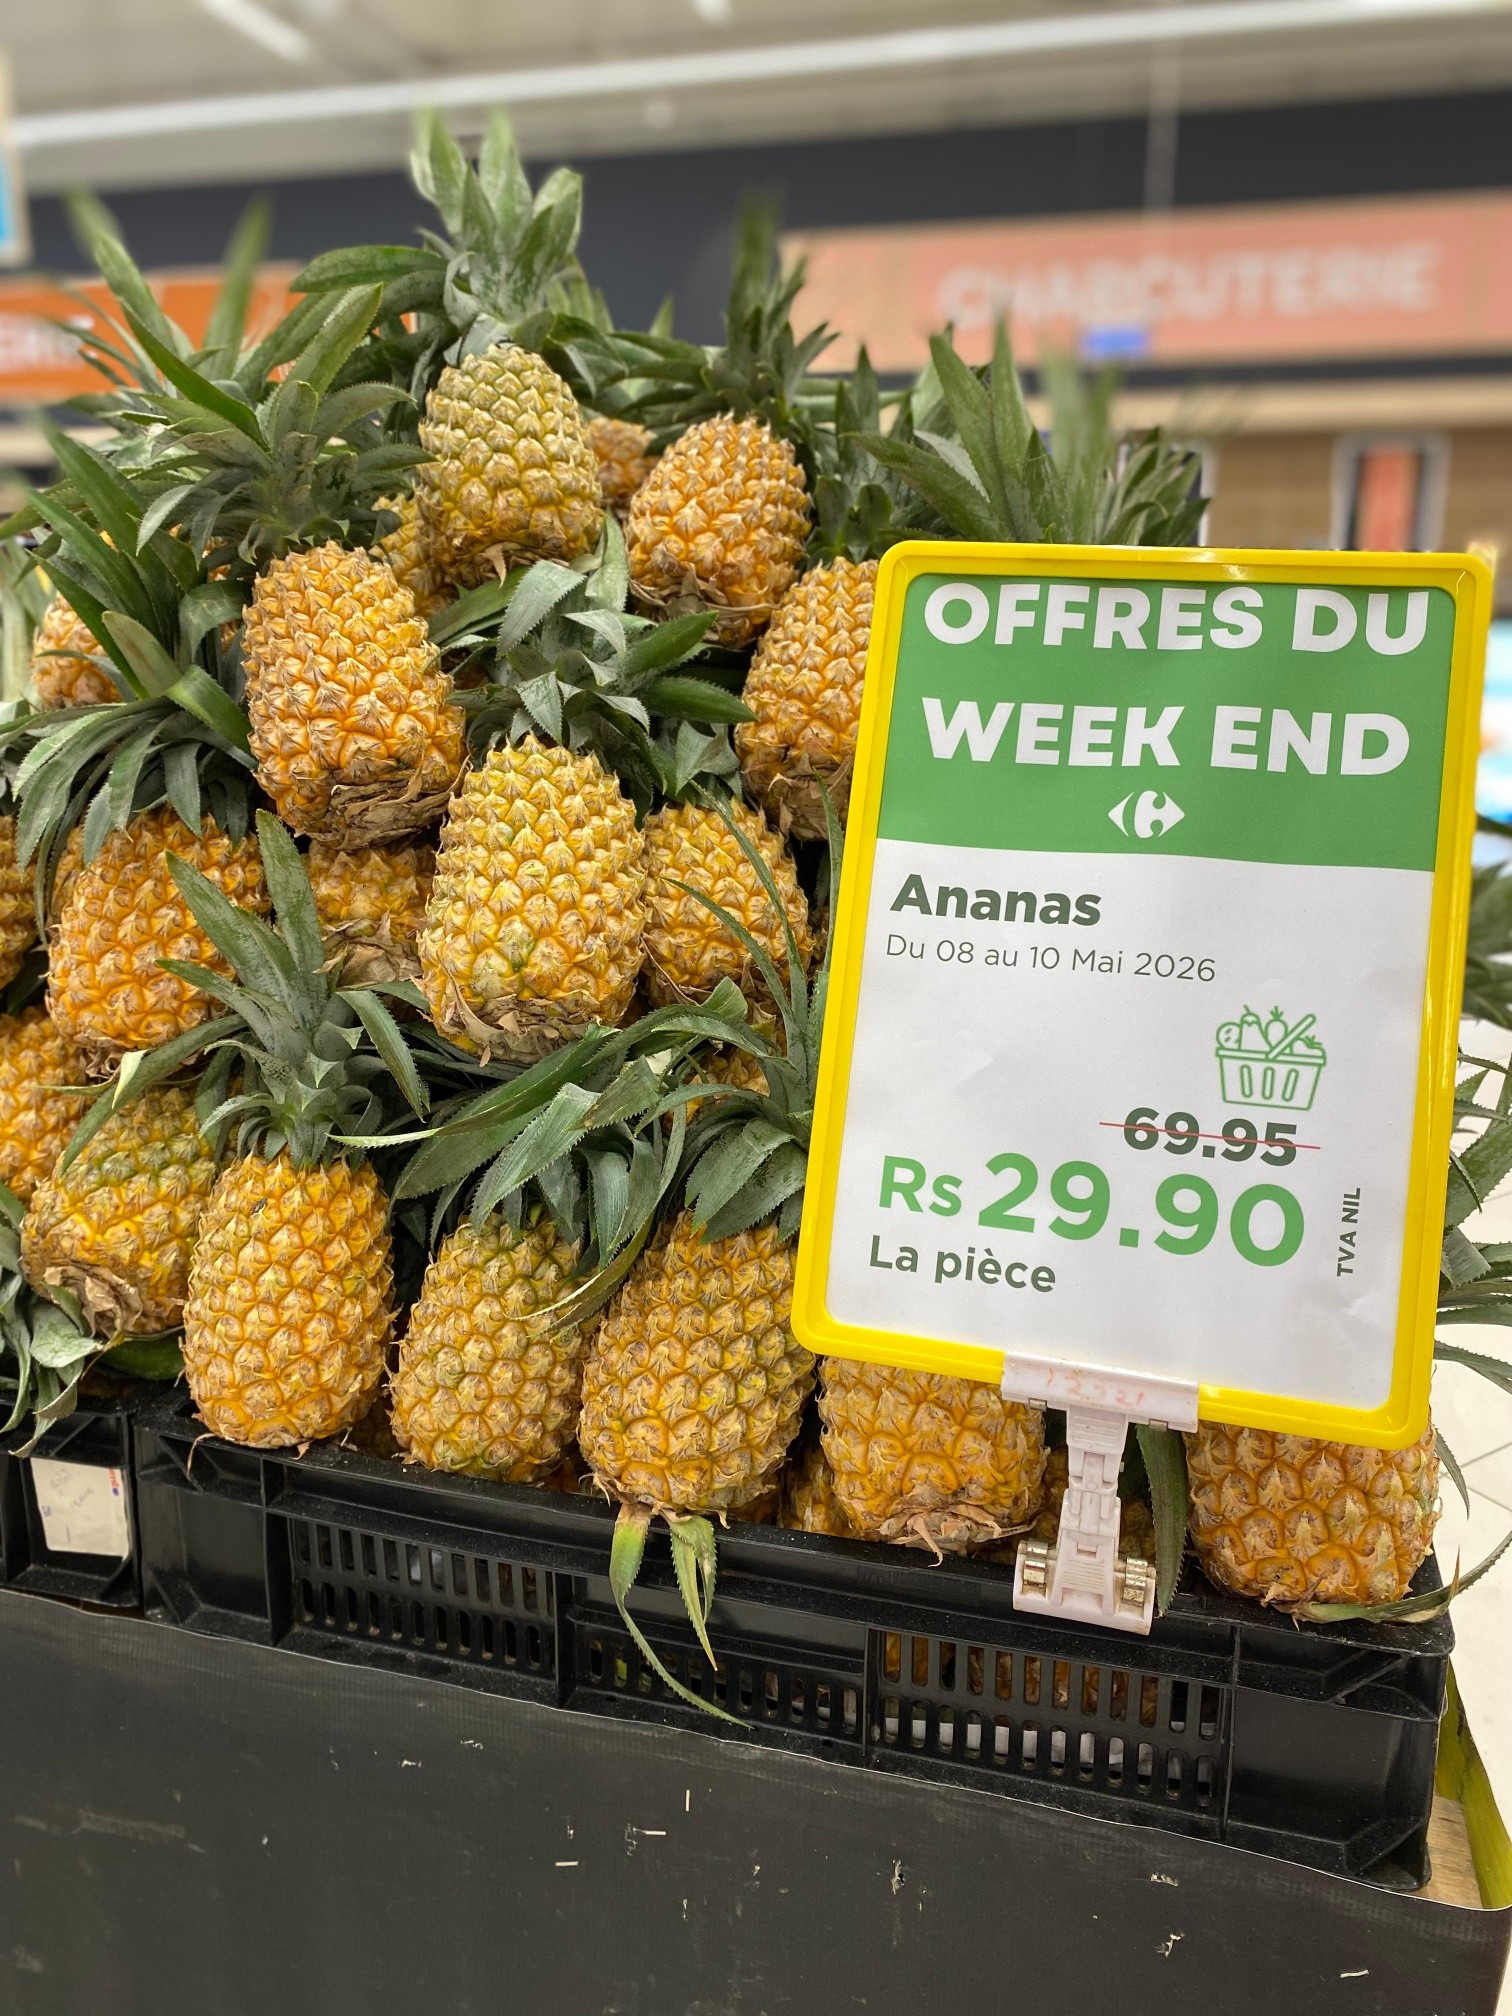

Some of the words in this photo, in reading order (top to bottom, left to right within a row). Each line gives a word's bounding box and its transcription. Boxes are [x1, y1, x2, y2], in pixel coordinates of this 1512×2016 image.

[923, 582, 1264, 651] OFFRES
[1291, 588, 1429, 656] DU
[921, 696, 1185, 767] WEEK
[1210, 706, 1410, 776] END
[890, 873, 1102, 927] Ananas
[886, 934, 925, 959] Du
[935, 938, 974, 964] 08
[984, 949, 1019, 968] au
[1029, 946, 1060, 971] 10
[1072, 949, 1123, 975] Mai
[1134, 952, 1217, 982] 2026
[1123, 1107, 1298, 1167] 69.95
[878, 1154, 963, 1218] Rs
[977, 1152, 1306, 1267] 29.90
[1340, 1186, 1361, 1224] NIL
[869, 1234, 919, 1273] La
[934, 1246, 1057, 1293] pièce
[1336, 1230, 1357, 1277] TVA
